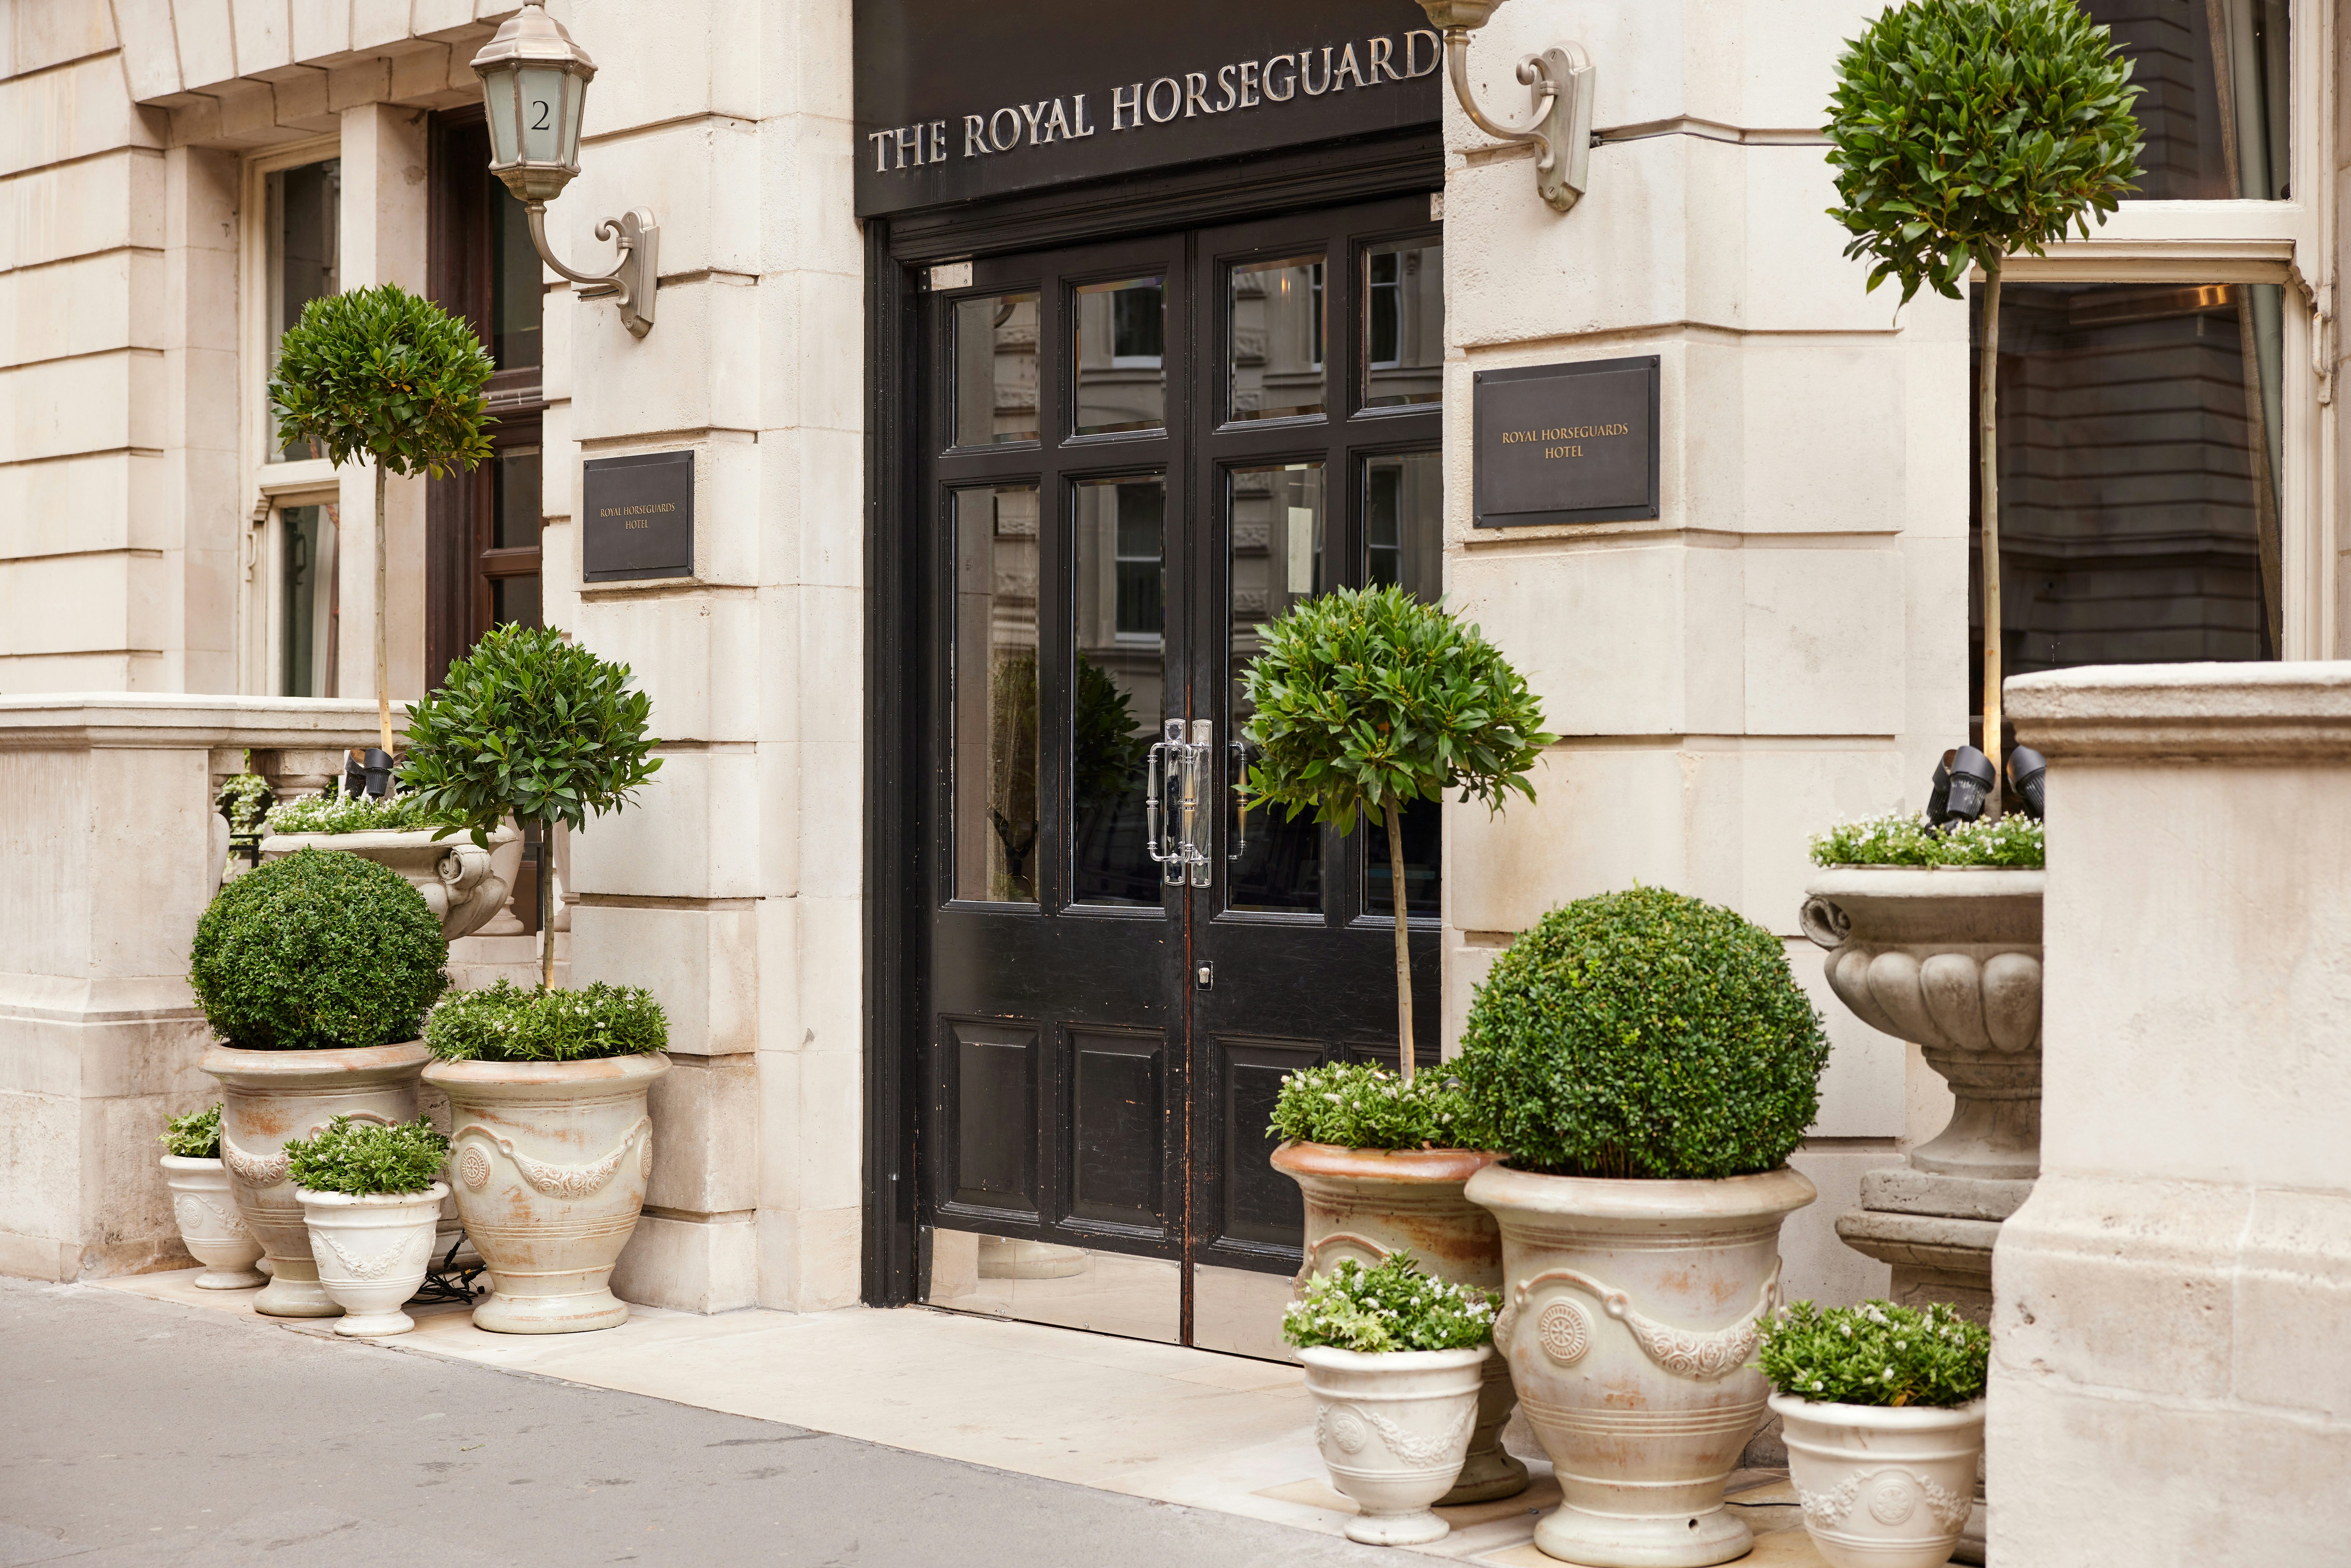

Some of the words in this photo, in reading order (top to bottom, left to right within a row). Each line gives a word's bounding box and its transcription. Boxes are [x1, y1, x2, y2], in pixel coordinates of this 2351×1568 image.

[868, 120, 947, 172] THE
[963, 94, 1094, 157] ROYAL
[1110, 30, 1441, 131] HORSEGUARD
[531, 100, 550, 130] 2
[1503, 431, 1538, 443] ROYAL
[1542, 423, 1628, 441] HORSEGUARDS
[1545, 445, 1584, 459] HOTEL
[600, 507, 621, 517] ROYAL
[624, 503, 675, 515] HORSEGUARDS
[626, 520, 648, 529] HOTEL
